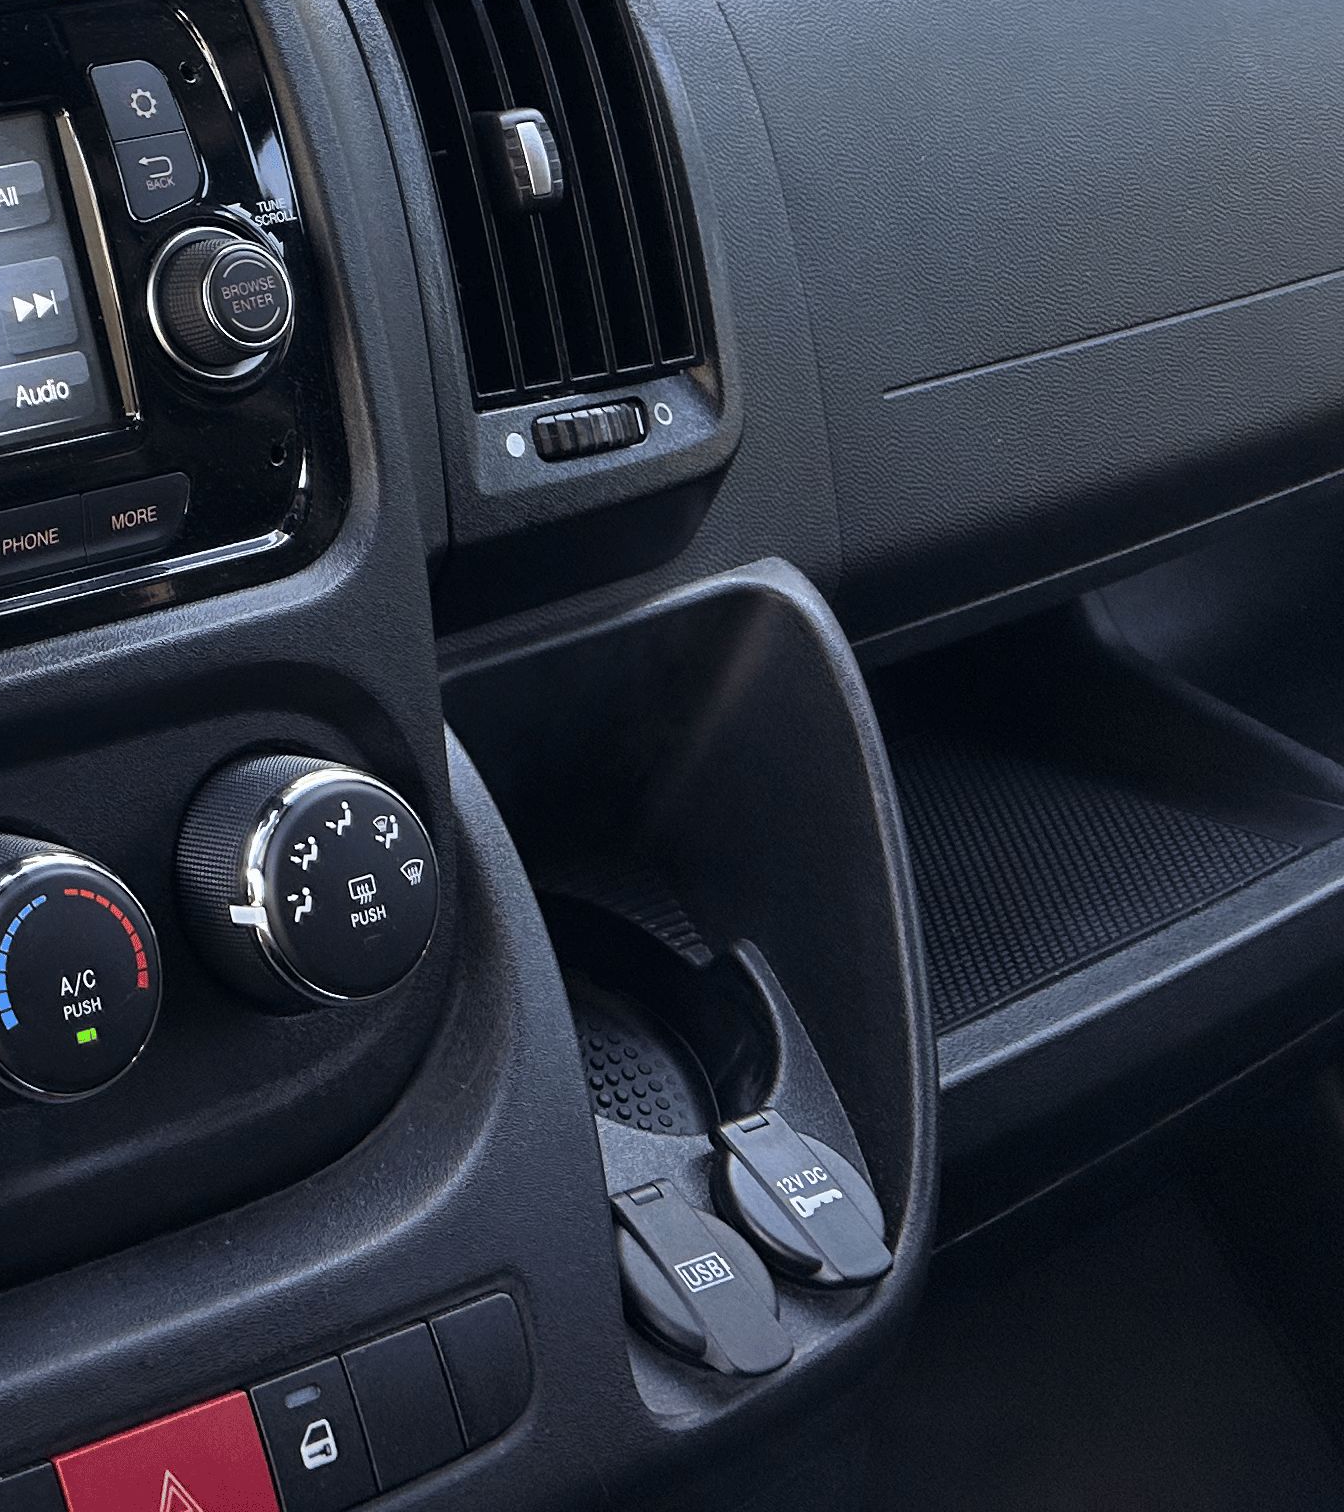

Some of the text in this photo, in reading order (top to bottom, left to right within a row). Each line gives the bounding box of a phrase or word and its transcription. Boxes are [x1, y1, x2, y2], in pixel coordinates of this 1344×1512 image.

[146, 178, 175, 191] BACK
[254, 208, 297, 226] SCROLL
[255, 198, 287, 213] TUNE
[220, 276, 276, 300] BROWSE
[231, 293, 274, 315] ENTER
[15, 377, 71, 408] Audio
[111, 505, 158, 531] MORE
[1, 527, 60, 556] PHONE
[350, 904, 387, 928] PUSH
[60, 969, 96, 997] A/C
[63, 996, 102, 1021] PUSH
[776, 1166, 828, 1195] 12V DC
[682, 1259, 725, 1286] USB
